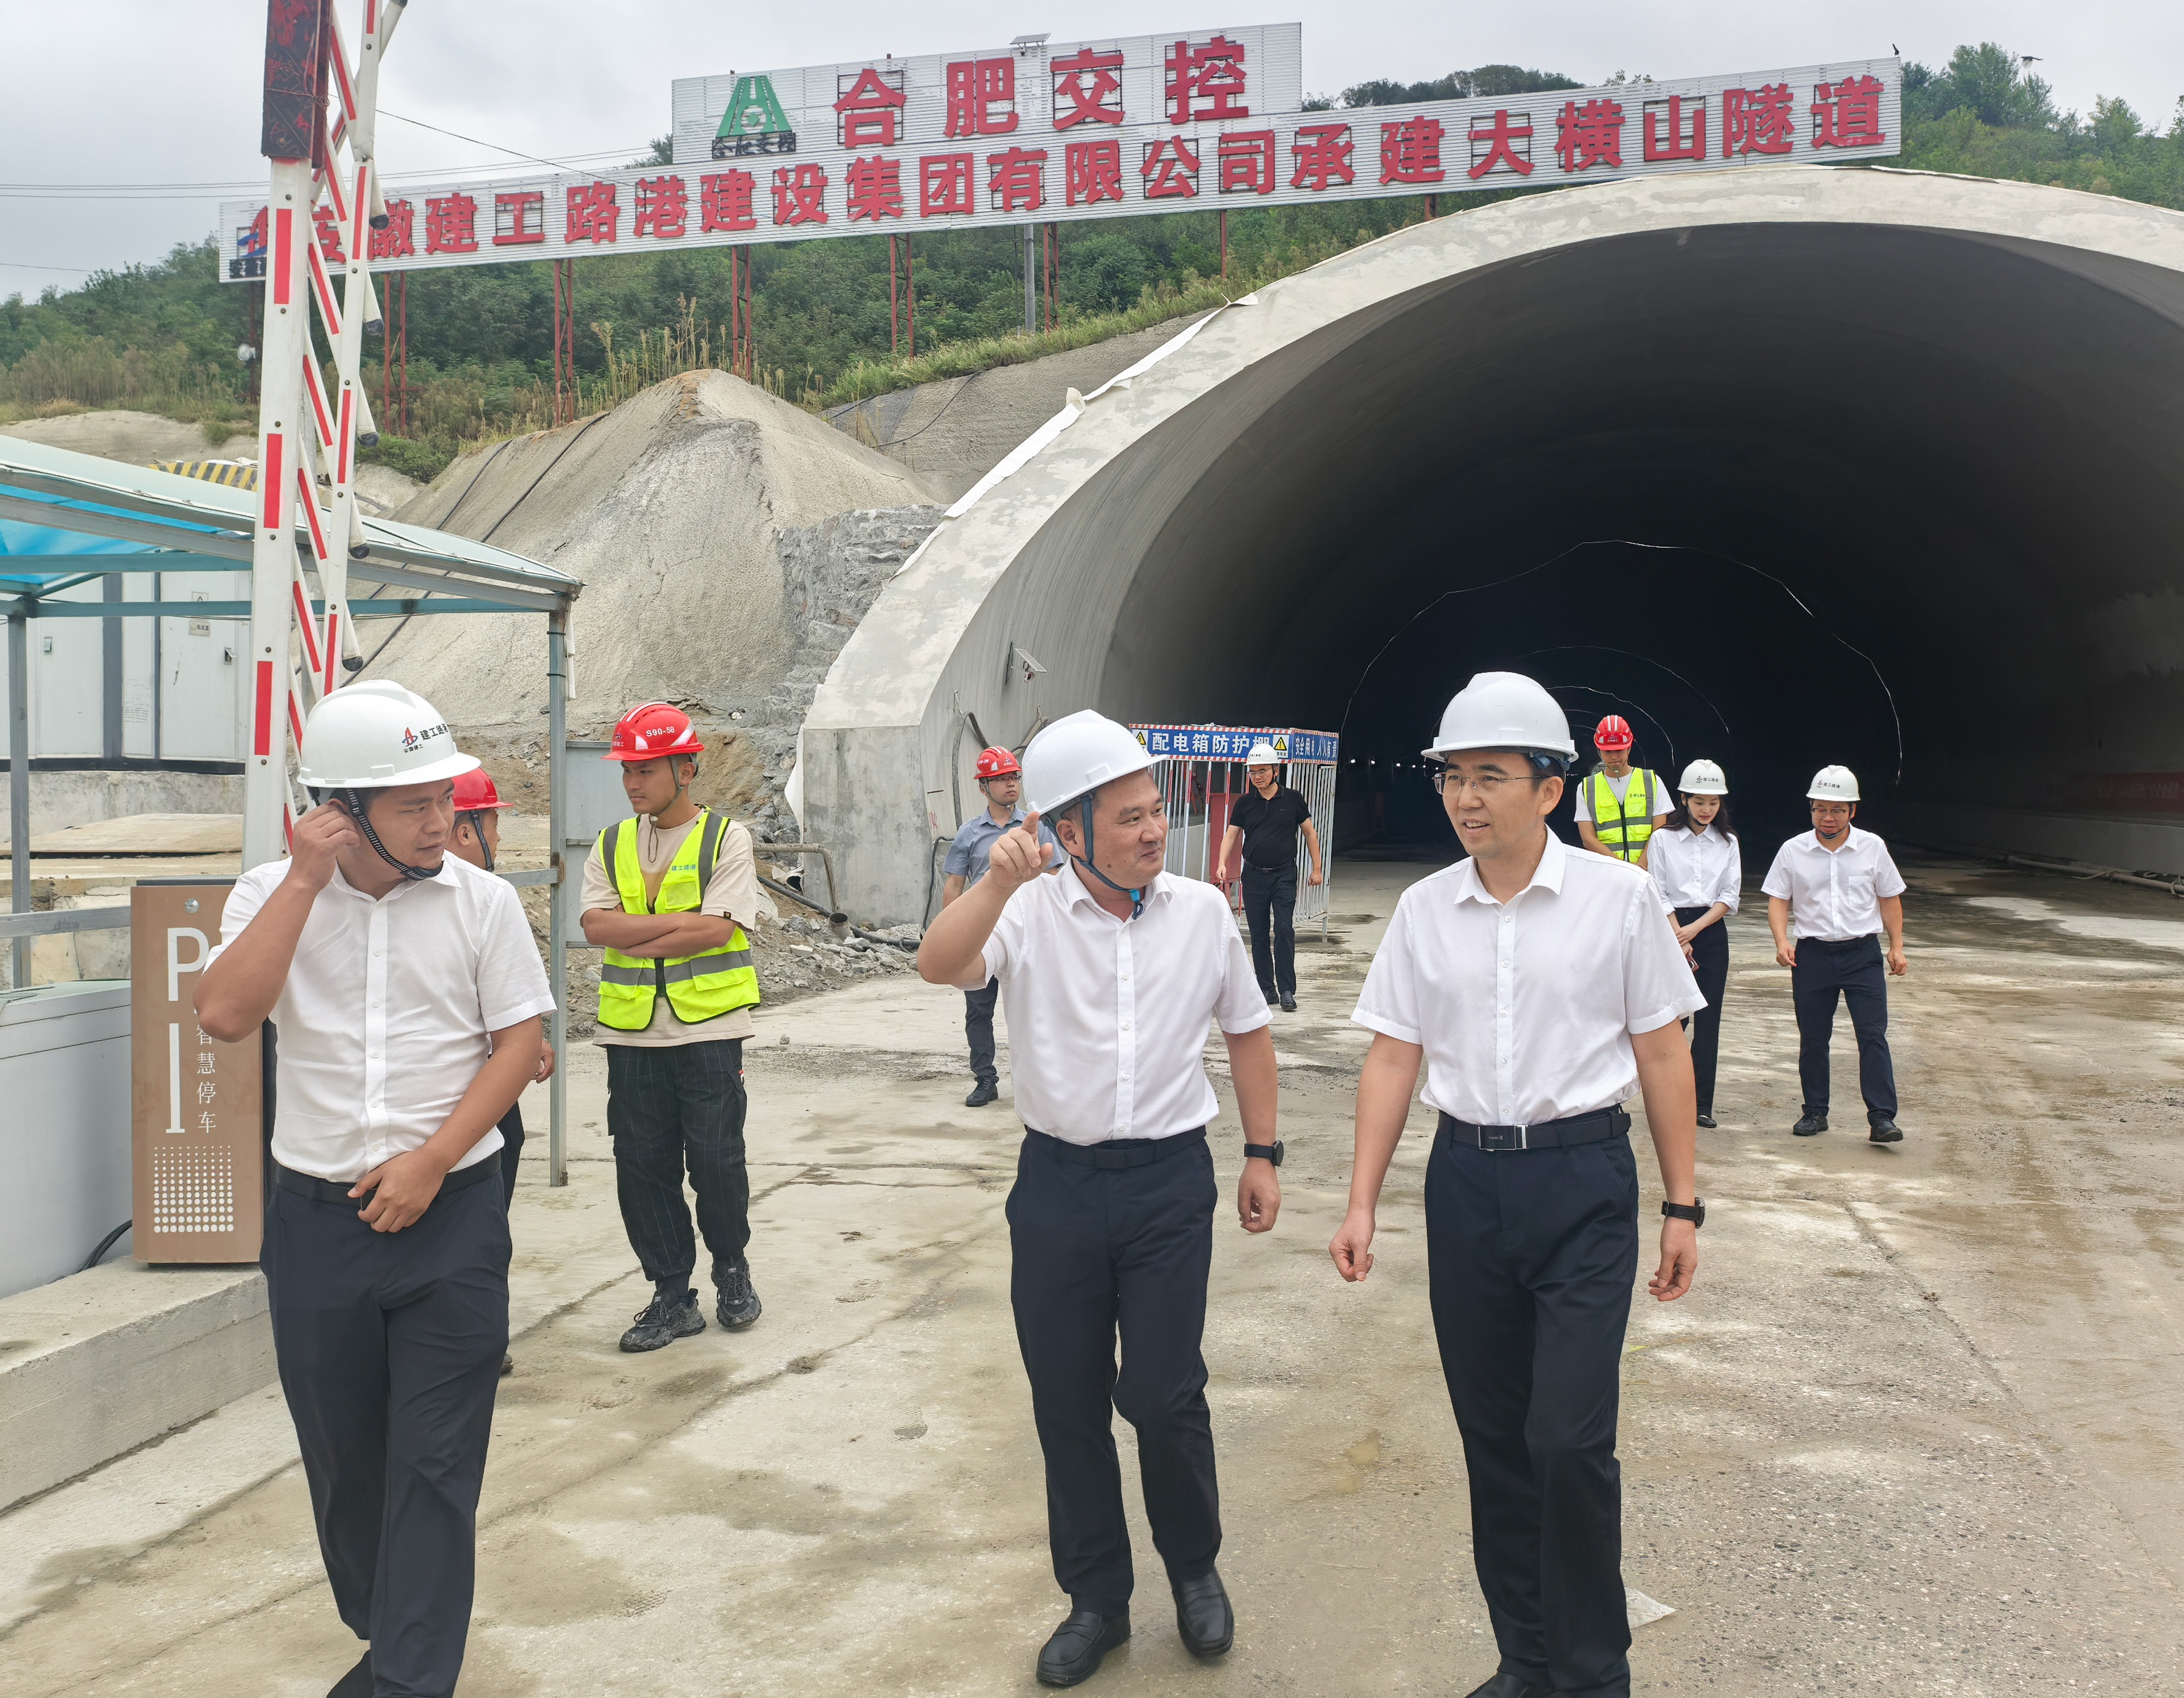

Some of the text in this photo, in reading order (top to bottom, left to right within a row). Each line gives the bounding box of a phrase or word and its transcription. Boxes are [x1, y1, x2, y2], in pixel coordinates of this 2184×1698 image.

[833, 36, 1249, 148] 合肥交控
[194, 1008, 217, 1134] 智慧停车
